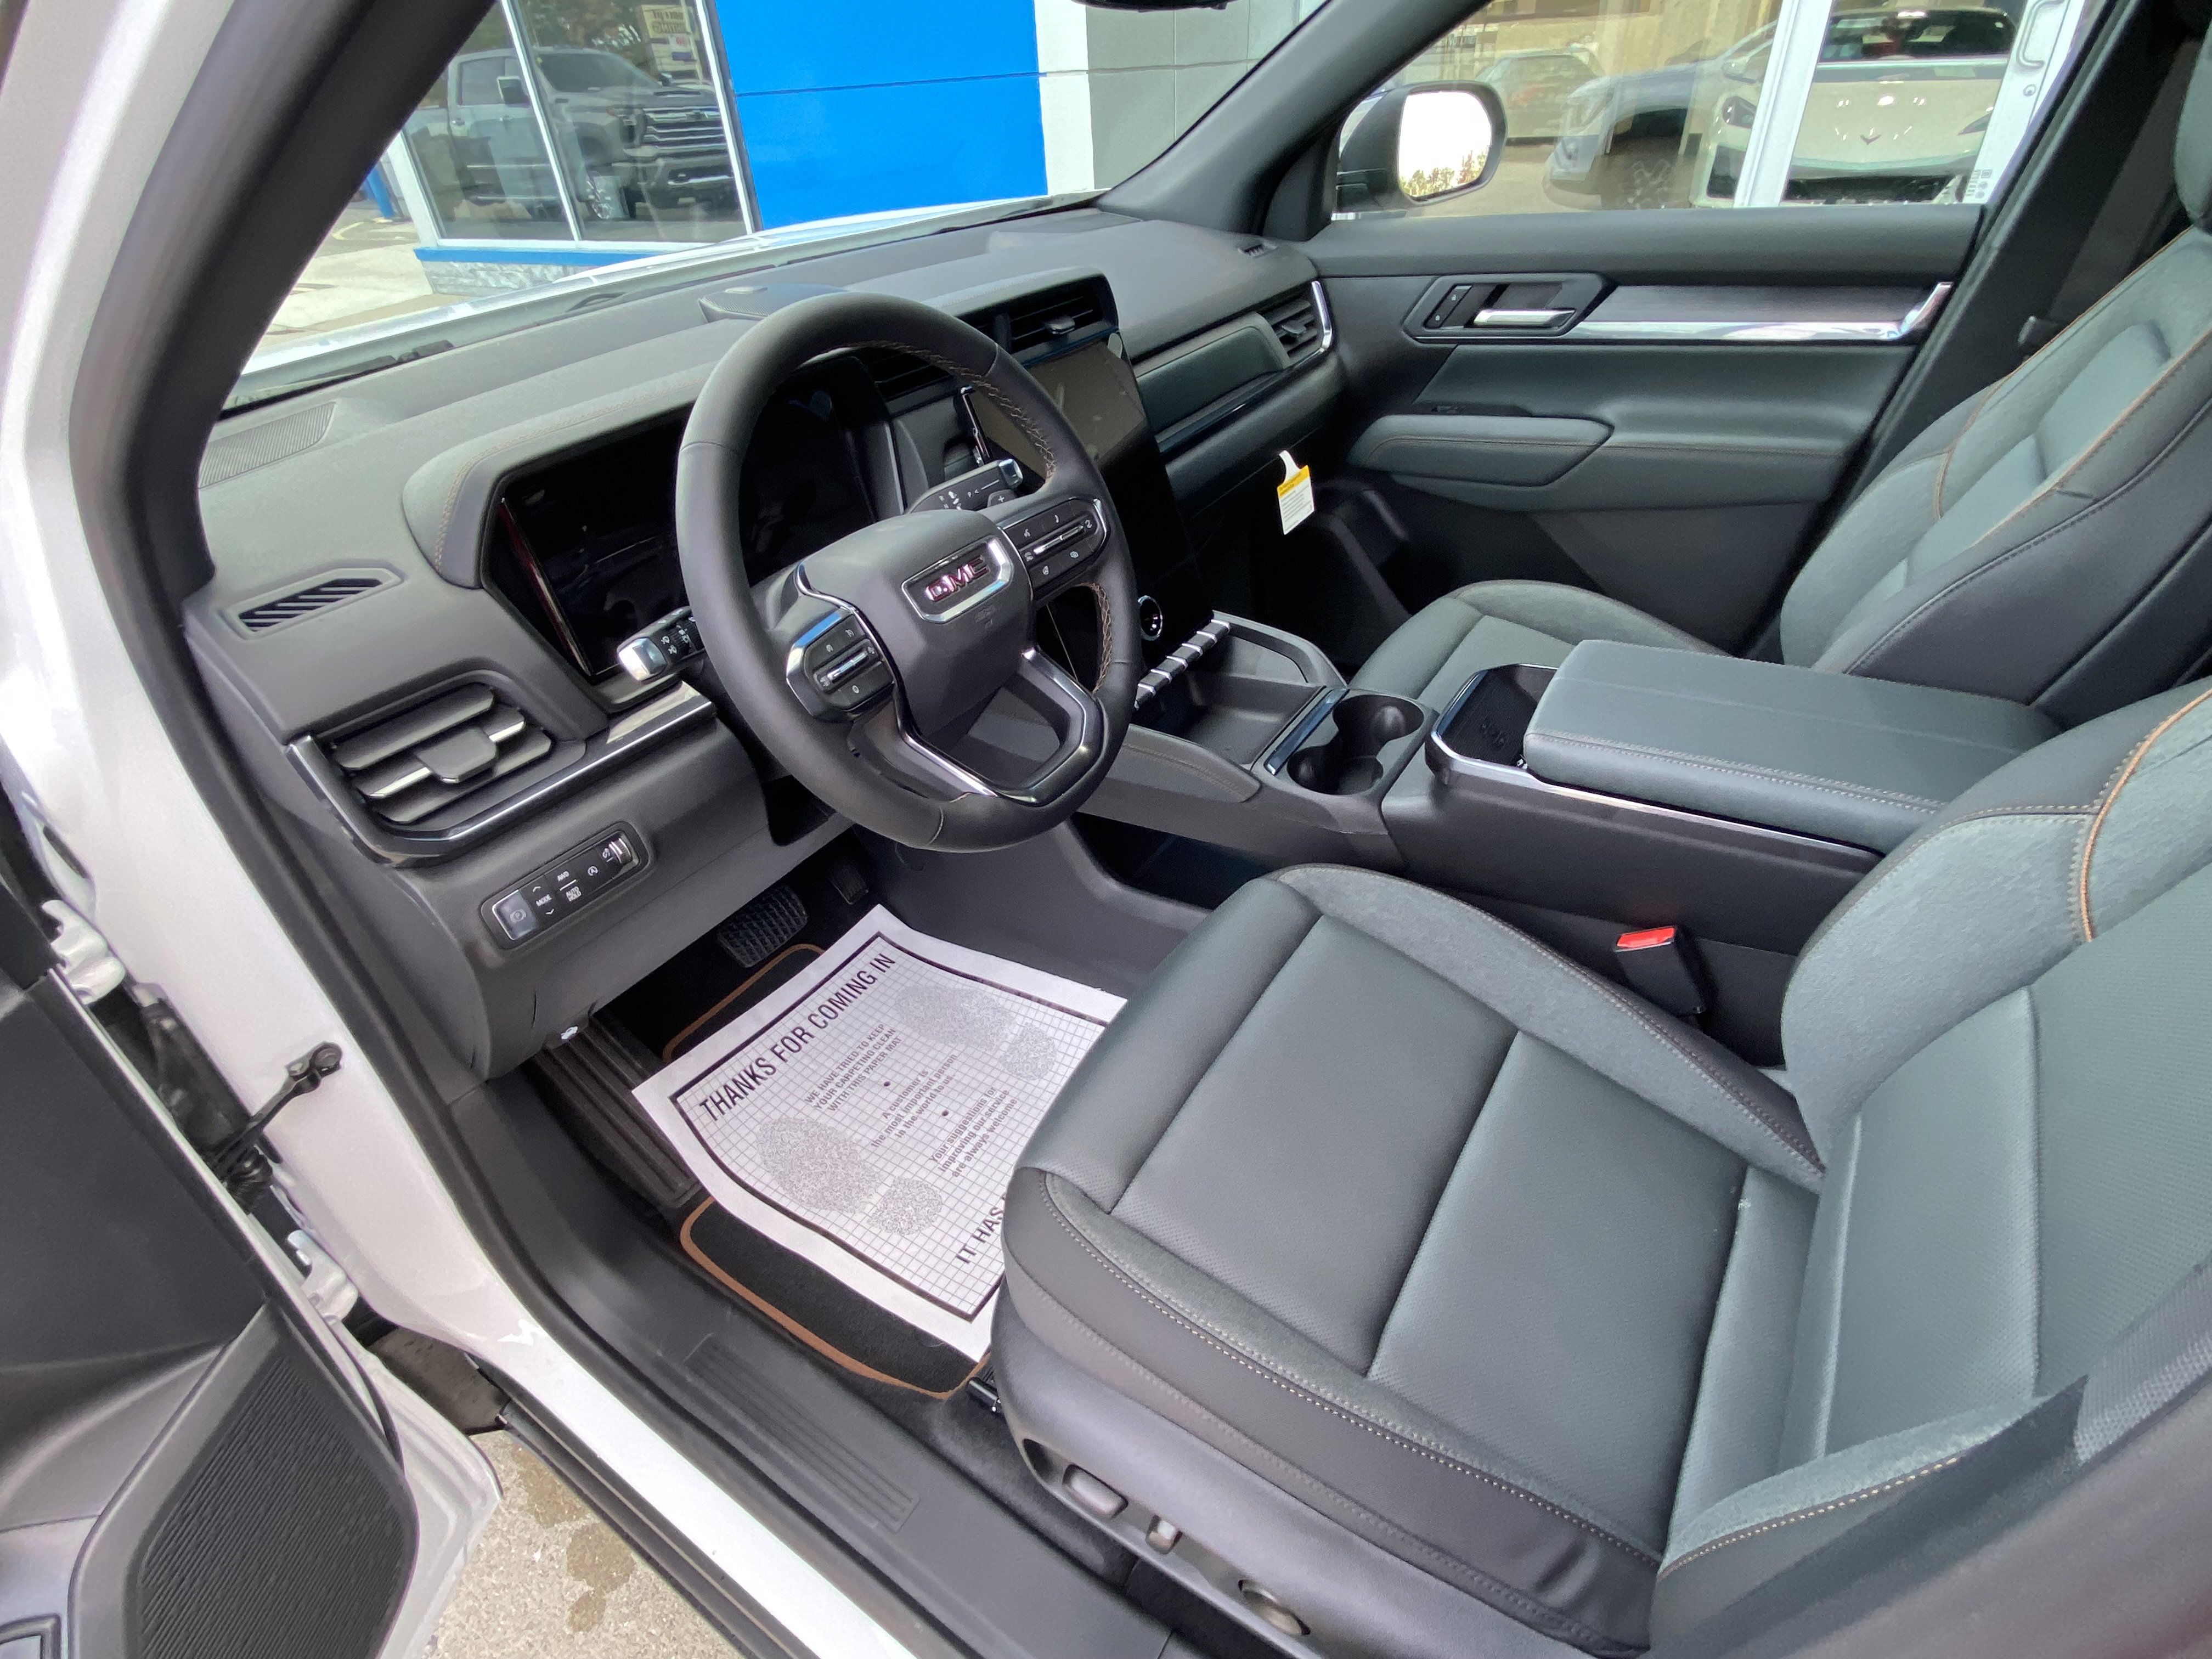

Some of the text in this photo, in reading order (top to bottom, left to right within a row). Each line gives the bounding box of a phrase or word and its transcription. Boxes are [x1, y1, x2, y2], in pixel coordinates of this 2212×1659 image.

[925, 555, 990, 602] GMC
[536, 894, 552, 906] MODE
[699, 953, 896, 1121] THANKS FOR COMING IN
[805, 1024, 884, 1103] WE HAVE TRIED TO KEEP
[814, 1028, 896, 1110] YOUR CARPETING CLEAN
[827, 1036, 902, 1111] WITH THIS PAPER MAT
[889, 1078, 921, 1111] customer
[919, 1070, 929, 1078] is
[871, 1054, 957, 1148] the most important person
[895, 1129, 906, 1138] in
[903, 1115, 918, 1129] the
[916, 1093, 936, 1115] world
[934, 1084, 944, 1093] to
[929, 1086, 997, 1163] Your suggestions for
[973, 1116, 986, 1131] our
[985, 1090, 1009, 1118] service
[952, 1162, 966, 1177] are
[964, 1132, 990, 1162] always
[955, 1206, 1005, 1265] IT HAS
